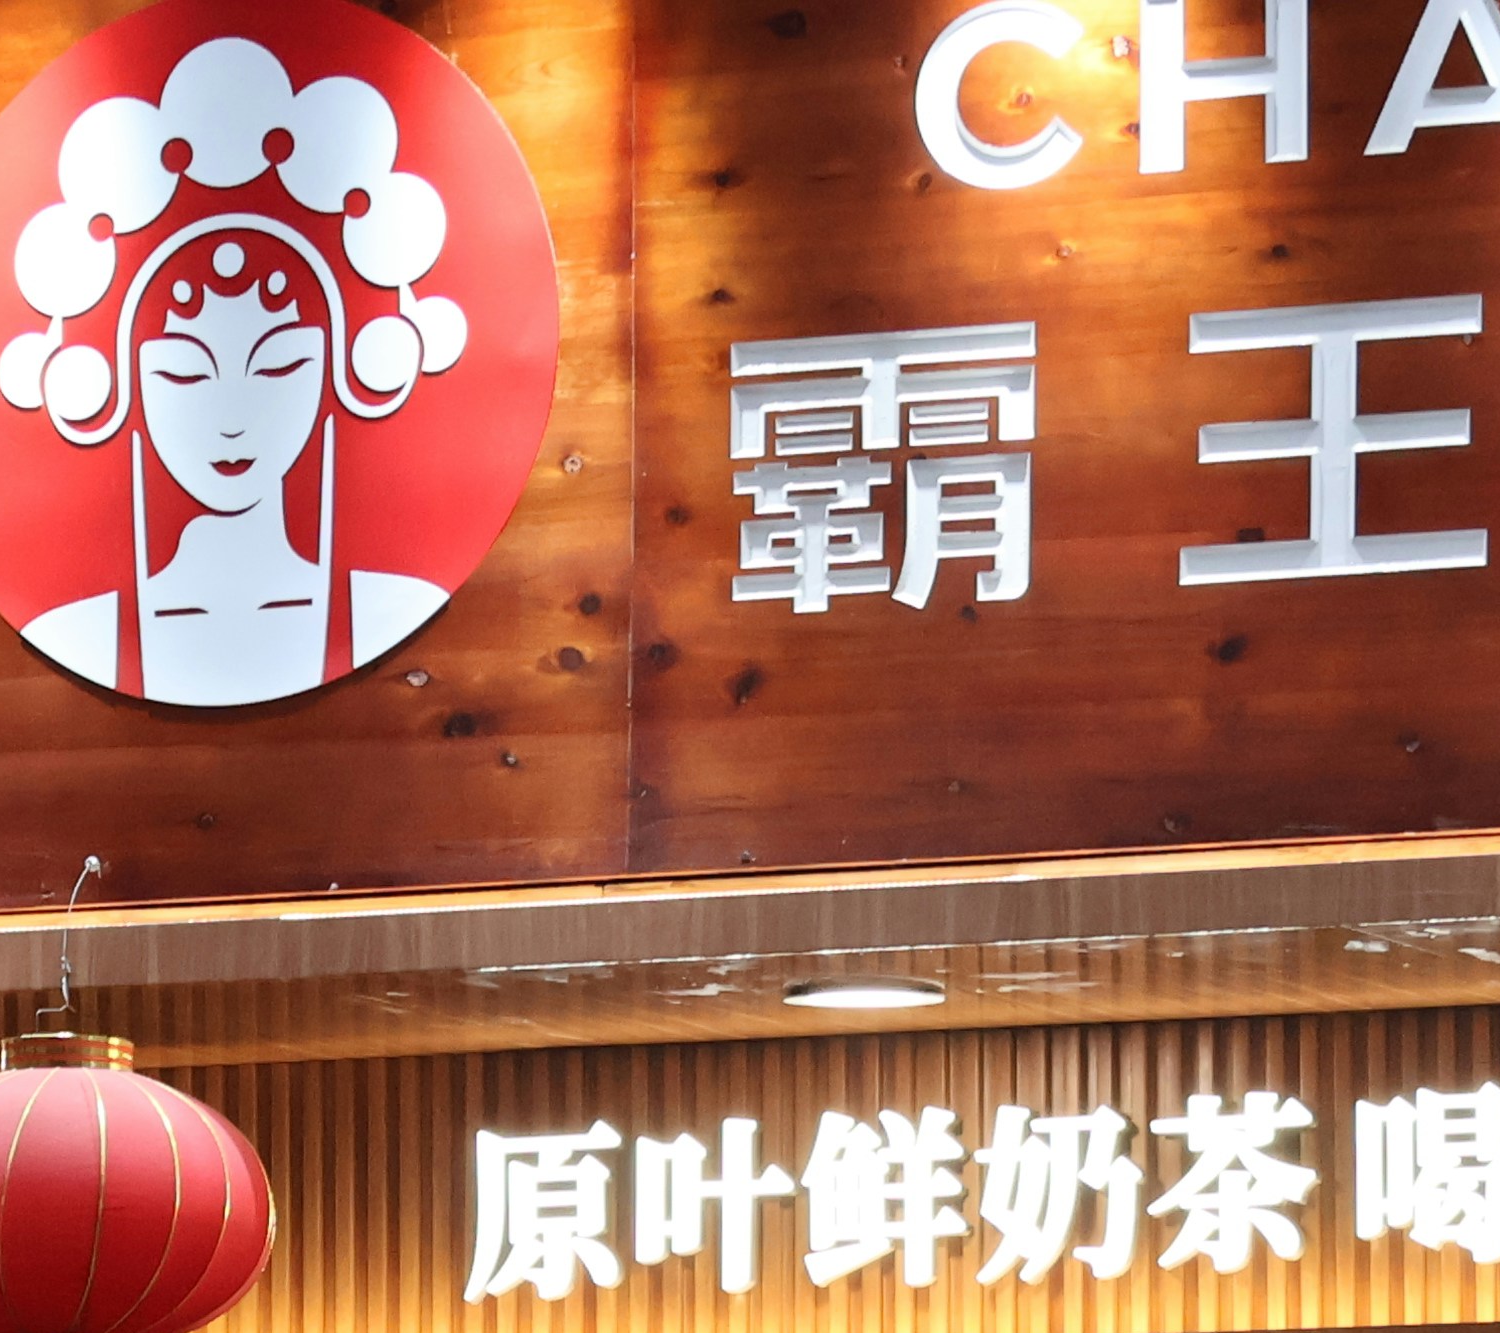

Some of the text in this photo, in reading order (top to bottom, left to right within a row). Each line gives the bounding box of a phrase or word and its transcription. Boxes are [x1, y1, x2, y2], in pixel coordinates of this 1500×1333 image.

[465, 1092, 1318, 1304] 原叶鲜奶茶
